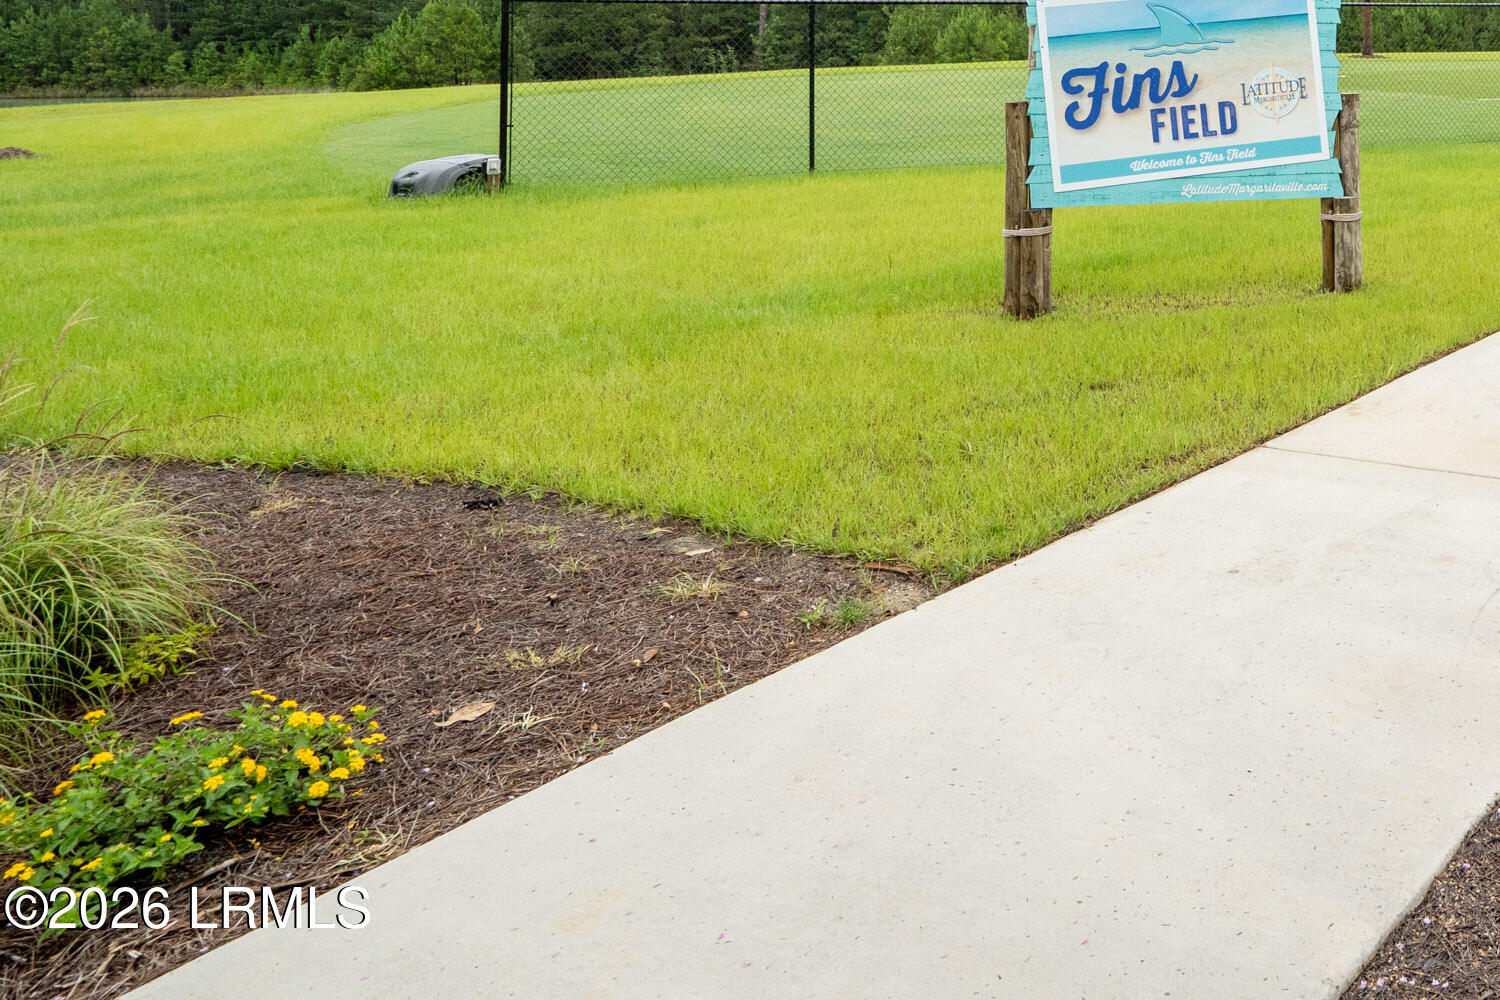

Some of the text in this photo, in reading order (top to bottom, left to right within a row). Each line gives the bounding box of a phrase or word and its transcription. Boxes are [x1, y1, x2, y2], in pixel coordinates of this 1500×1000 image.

[1061, 60, 1198, 130] Fins
[1240, 76, 1308, 106] LATITUDE
[1150, 100, 1238, 143] FIELD
[1130, 146, 1257, 172] Welcome to Fins Field
[1181, 182, 1329, 198] LatitudeMargaritaville.com
